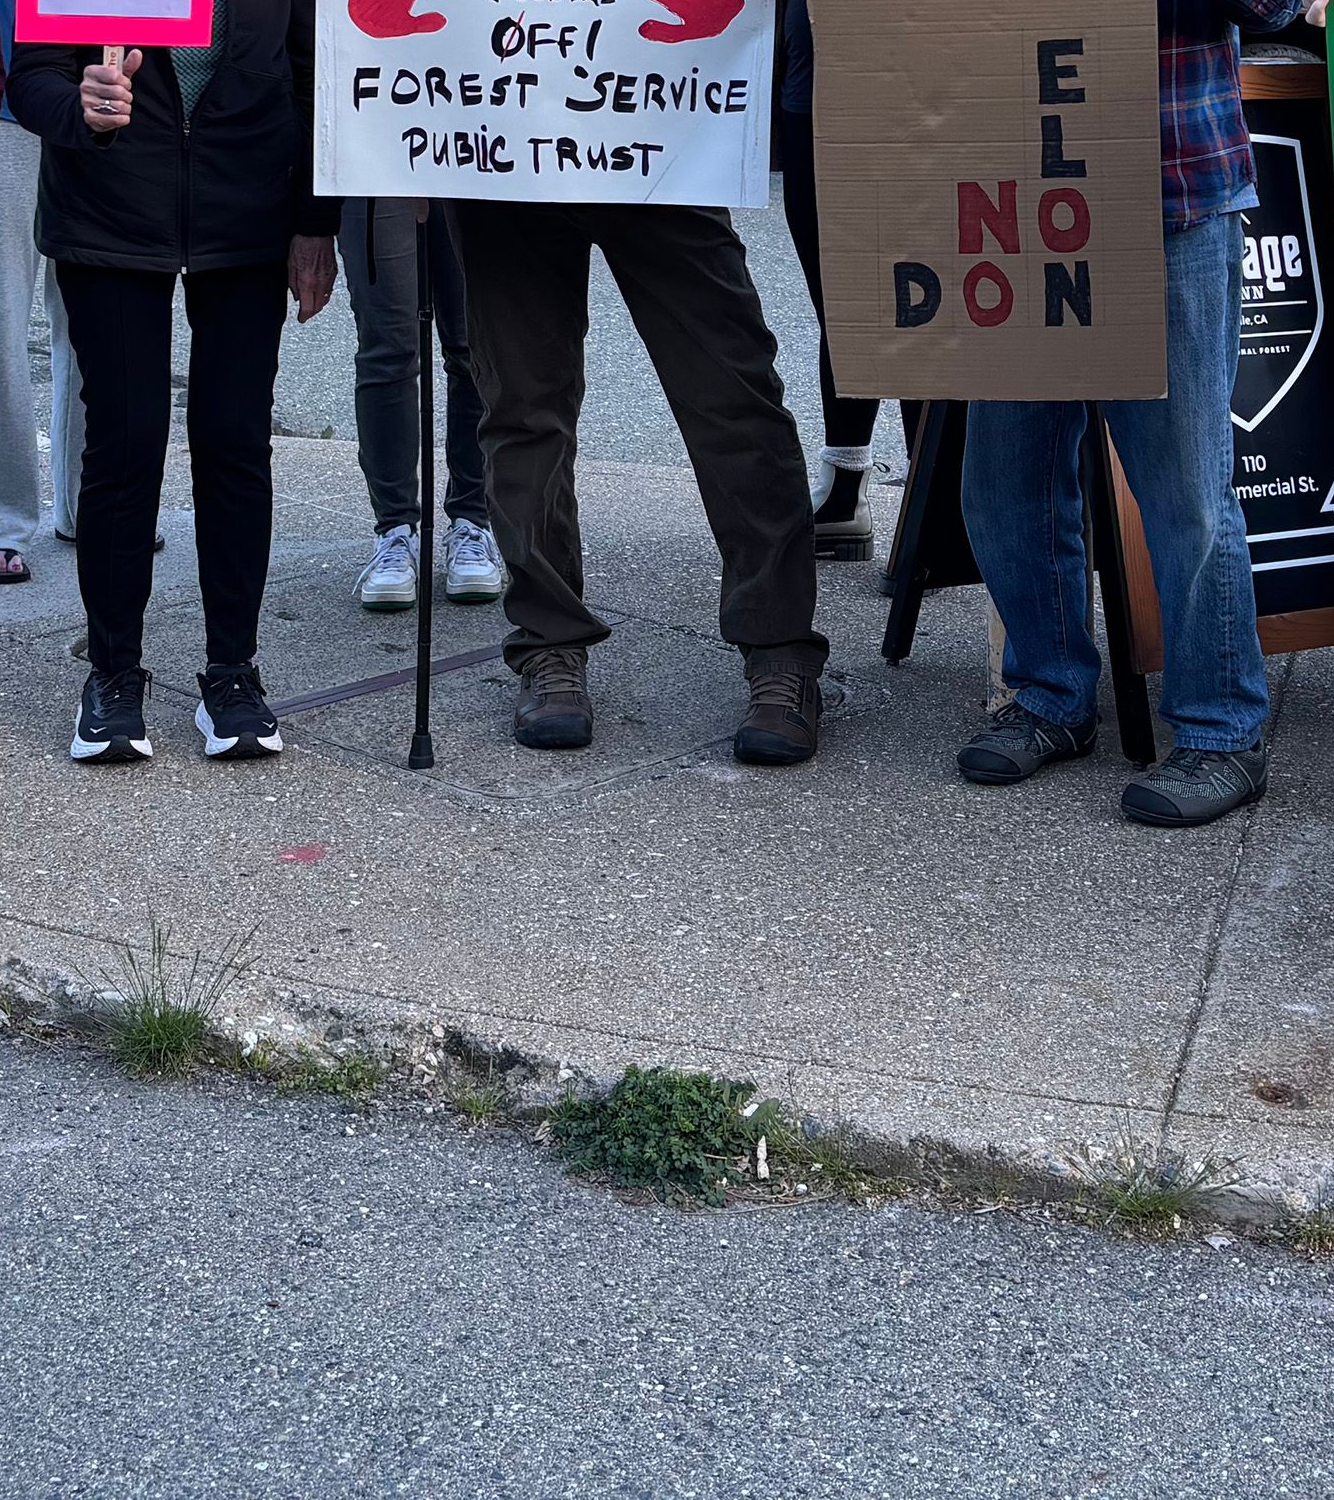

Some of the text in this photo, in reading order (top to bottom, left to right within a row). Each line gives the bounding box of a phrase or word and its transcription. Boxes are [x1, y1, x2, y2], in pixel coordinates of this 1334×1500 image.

[353, 66, 749, 114] FOREST SERVICE
[401, 124, 664, 176] PUBLIC TRUST
[1241, 235, 1303, 292] age
[894, 260, 1092, 328] DON
[1241, 285, 1264, 300] NN
[1254, 314, 1268, 325] CA
[1259, 345, 1290, 355] FOREST
[1241, 455, 1266, 472] 110
[1235, 476, 1319, 500] mercial St.
